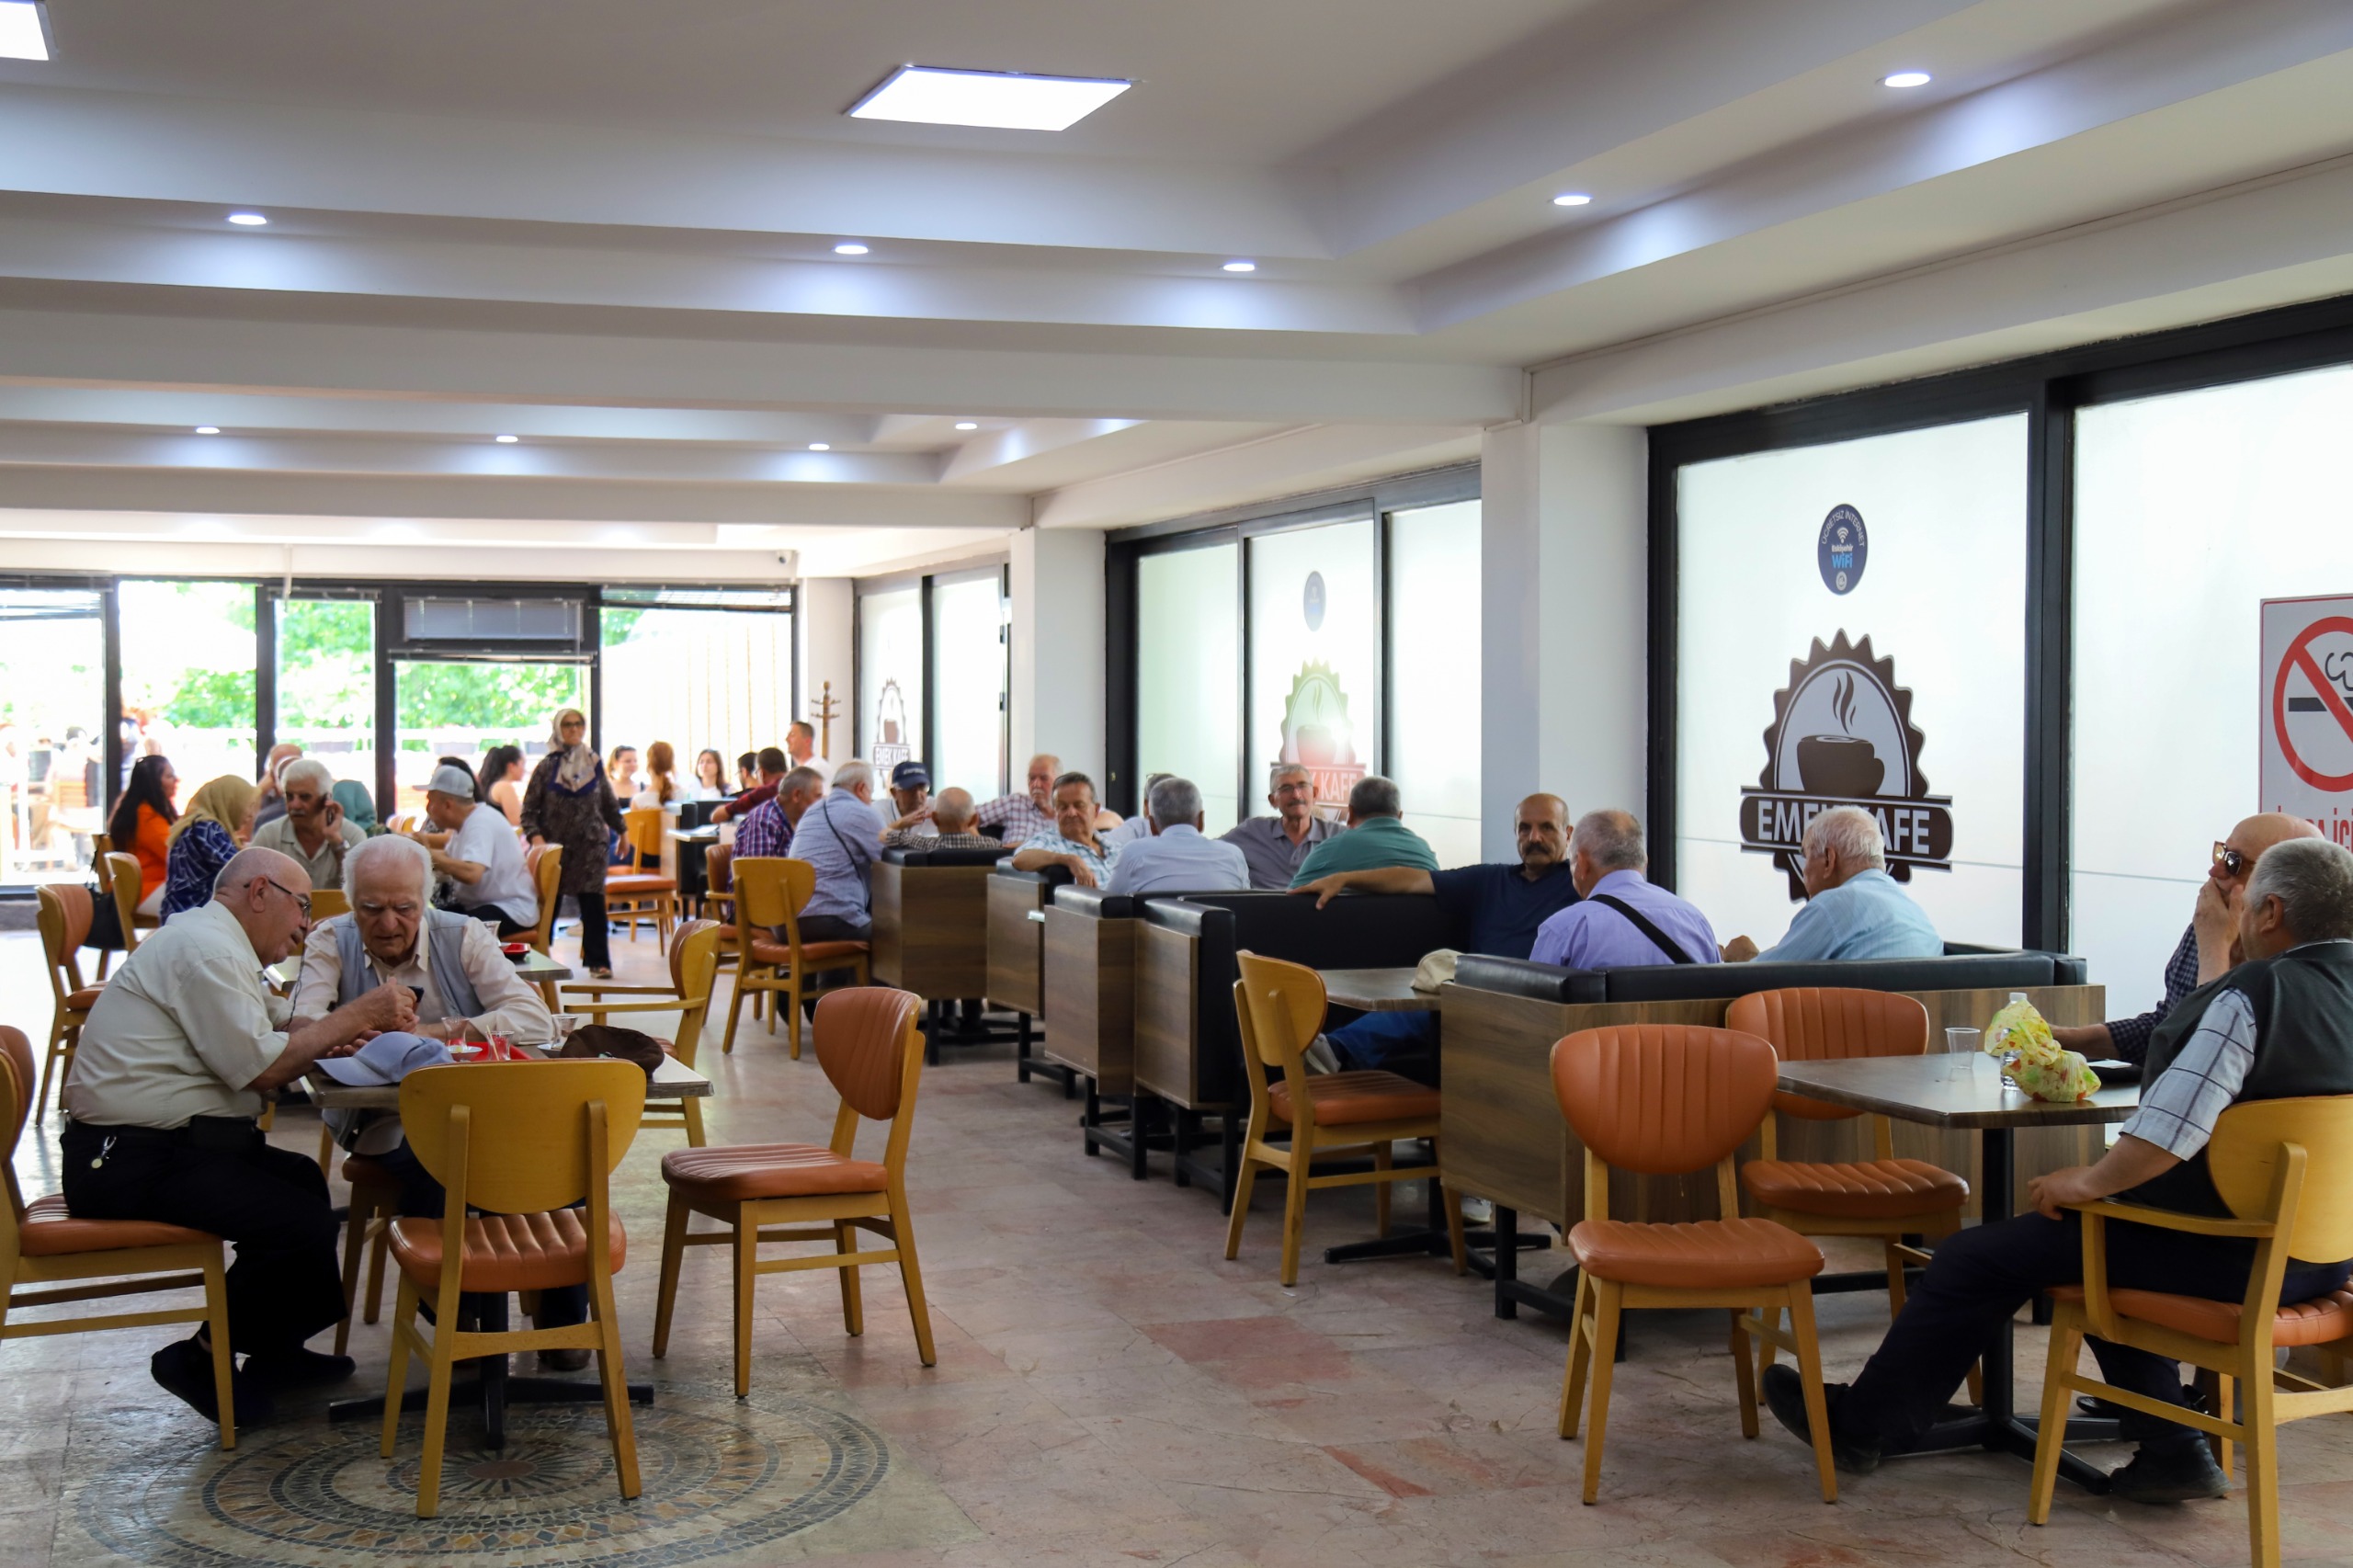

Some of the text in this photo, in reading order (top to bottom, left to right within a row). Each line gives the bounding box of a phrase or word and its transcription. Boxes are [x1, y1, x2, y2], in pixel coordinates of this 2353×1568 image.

[1832, 553, 1853, 568] WiFi
[1757, 800, 1930, 855] EME AFE
